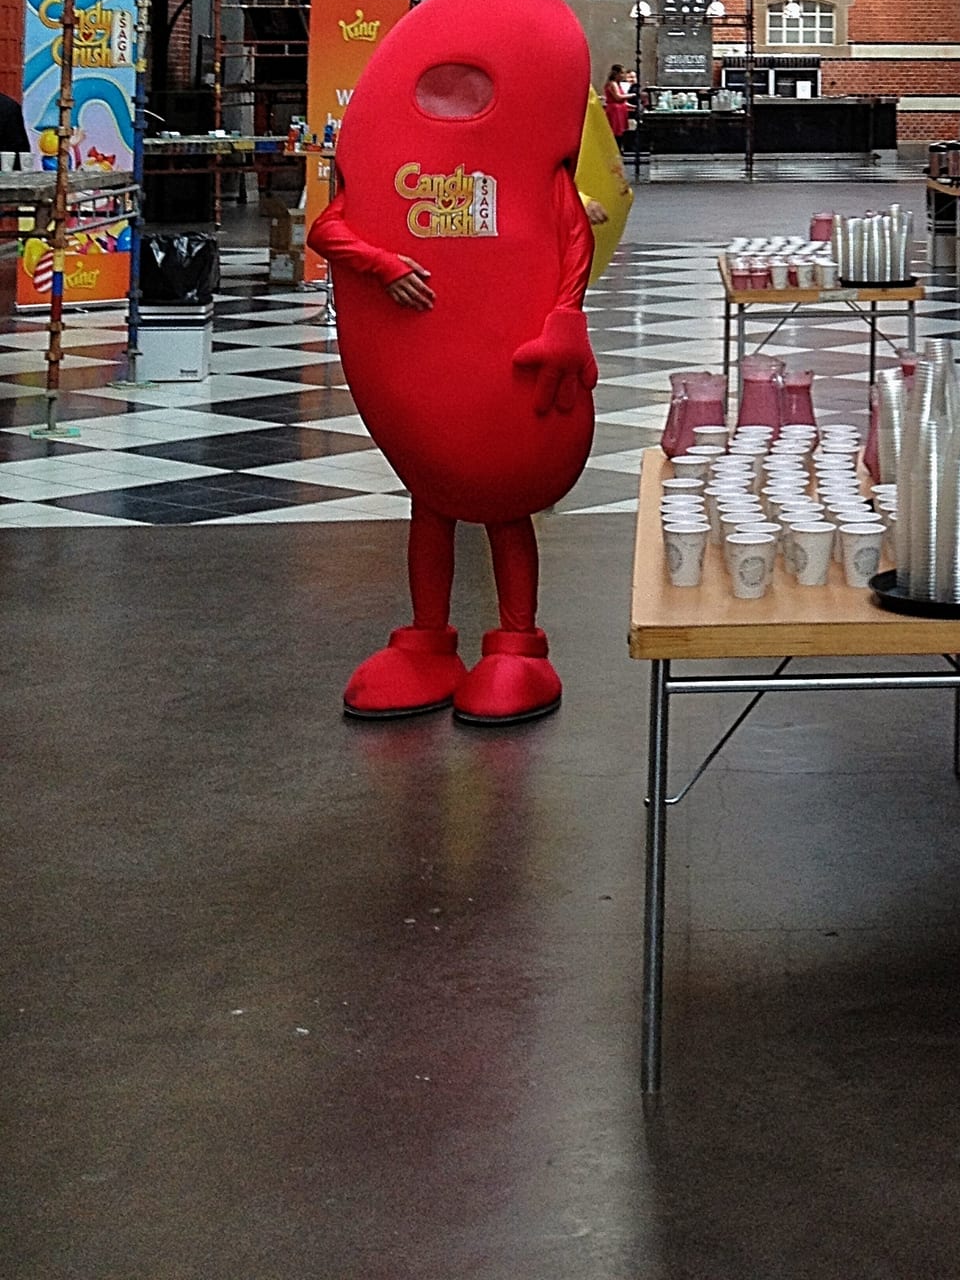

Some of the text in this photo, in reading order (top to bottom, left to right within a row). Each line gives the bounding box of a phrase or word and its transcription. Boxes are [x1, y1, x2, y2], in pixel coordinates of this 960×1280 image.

[117, 18, 128, 62] SAGA
[338, 9, 381, 41] King
[395, 162, 475, 202] Candy
[407, 200, 476, 238] Crush
[480, 185, 489, 231] SAGA
